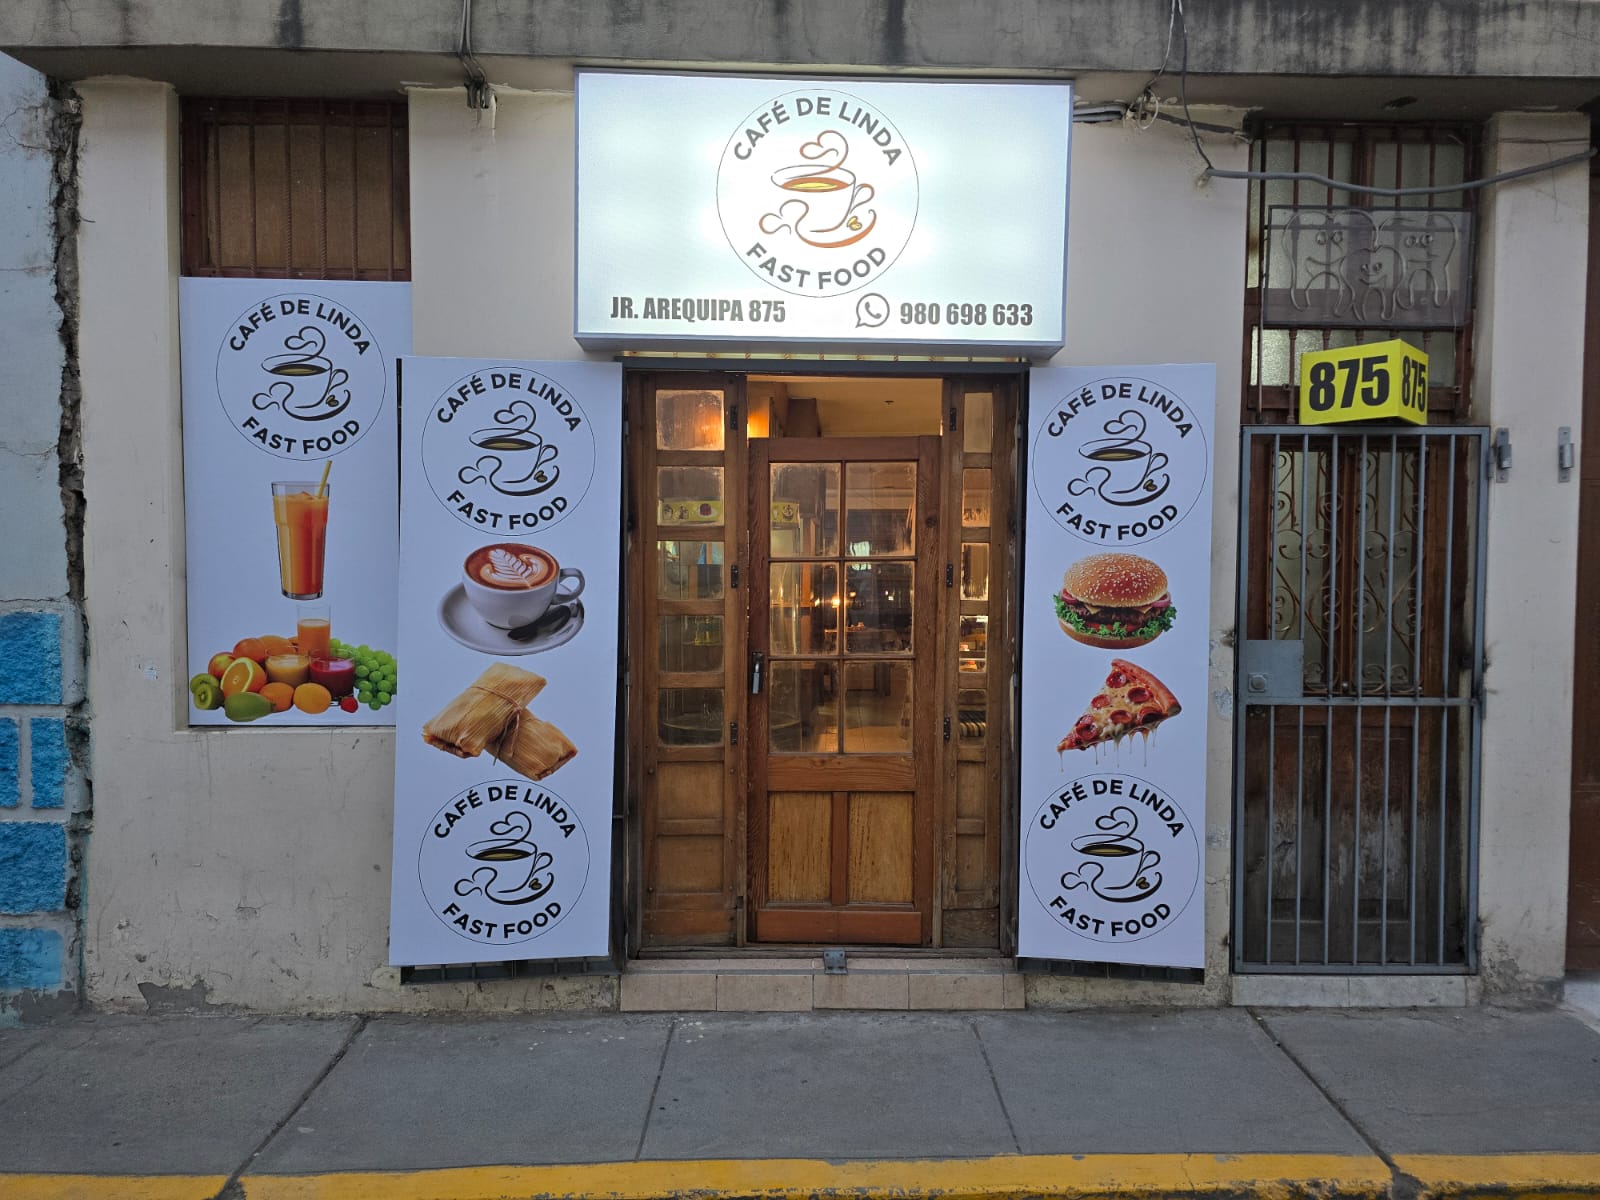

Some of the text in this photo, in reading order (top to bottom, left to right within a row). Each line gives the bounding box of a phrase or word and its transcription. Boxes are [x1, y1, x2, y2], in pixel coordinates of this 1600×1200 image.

[734, 96, 902, 166] CAFÉ DE LINDA
[746, 242, 887, 290] FAST FOOD
[229, 299, 371, 356] CAFÉ DE LINDA
[610, 296, 786, 325] JR. AREQUIPA 875
[900, 303, 1033, 327] 980 698 633
[437, 373, 582, 432] CAFÉ DE LINDA
[1309, 354, 1390, 411] 875
[1402, 355, 1426, 412] 875
[242, 416, 360, 454] FAST FOOD
[1048, 383, 1193, 438] CAFÉ DE LINDA
[447, 490, 568, 530] FAST FOOD
[1056, 502, 1178, 540] FAST FOOD
[434, 785, 576, 838] CAFÉ DE LINDA
[1040, 779, 1185, 838] CAFÉ DE LINDA
[442, 902, 562, 939] FAST FOOD
[1049, 895, 1171, 937] FAST FOOD
